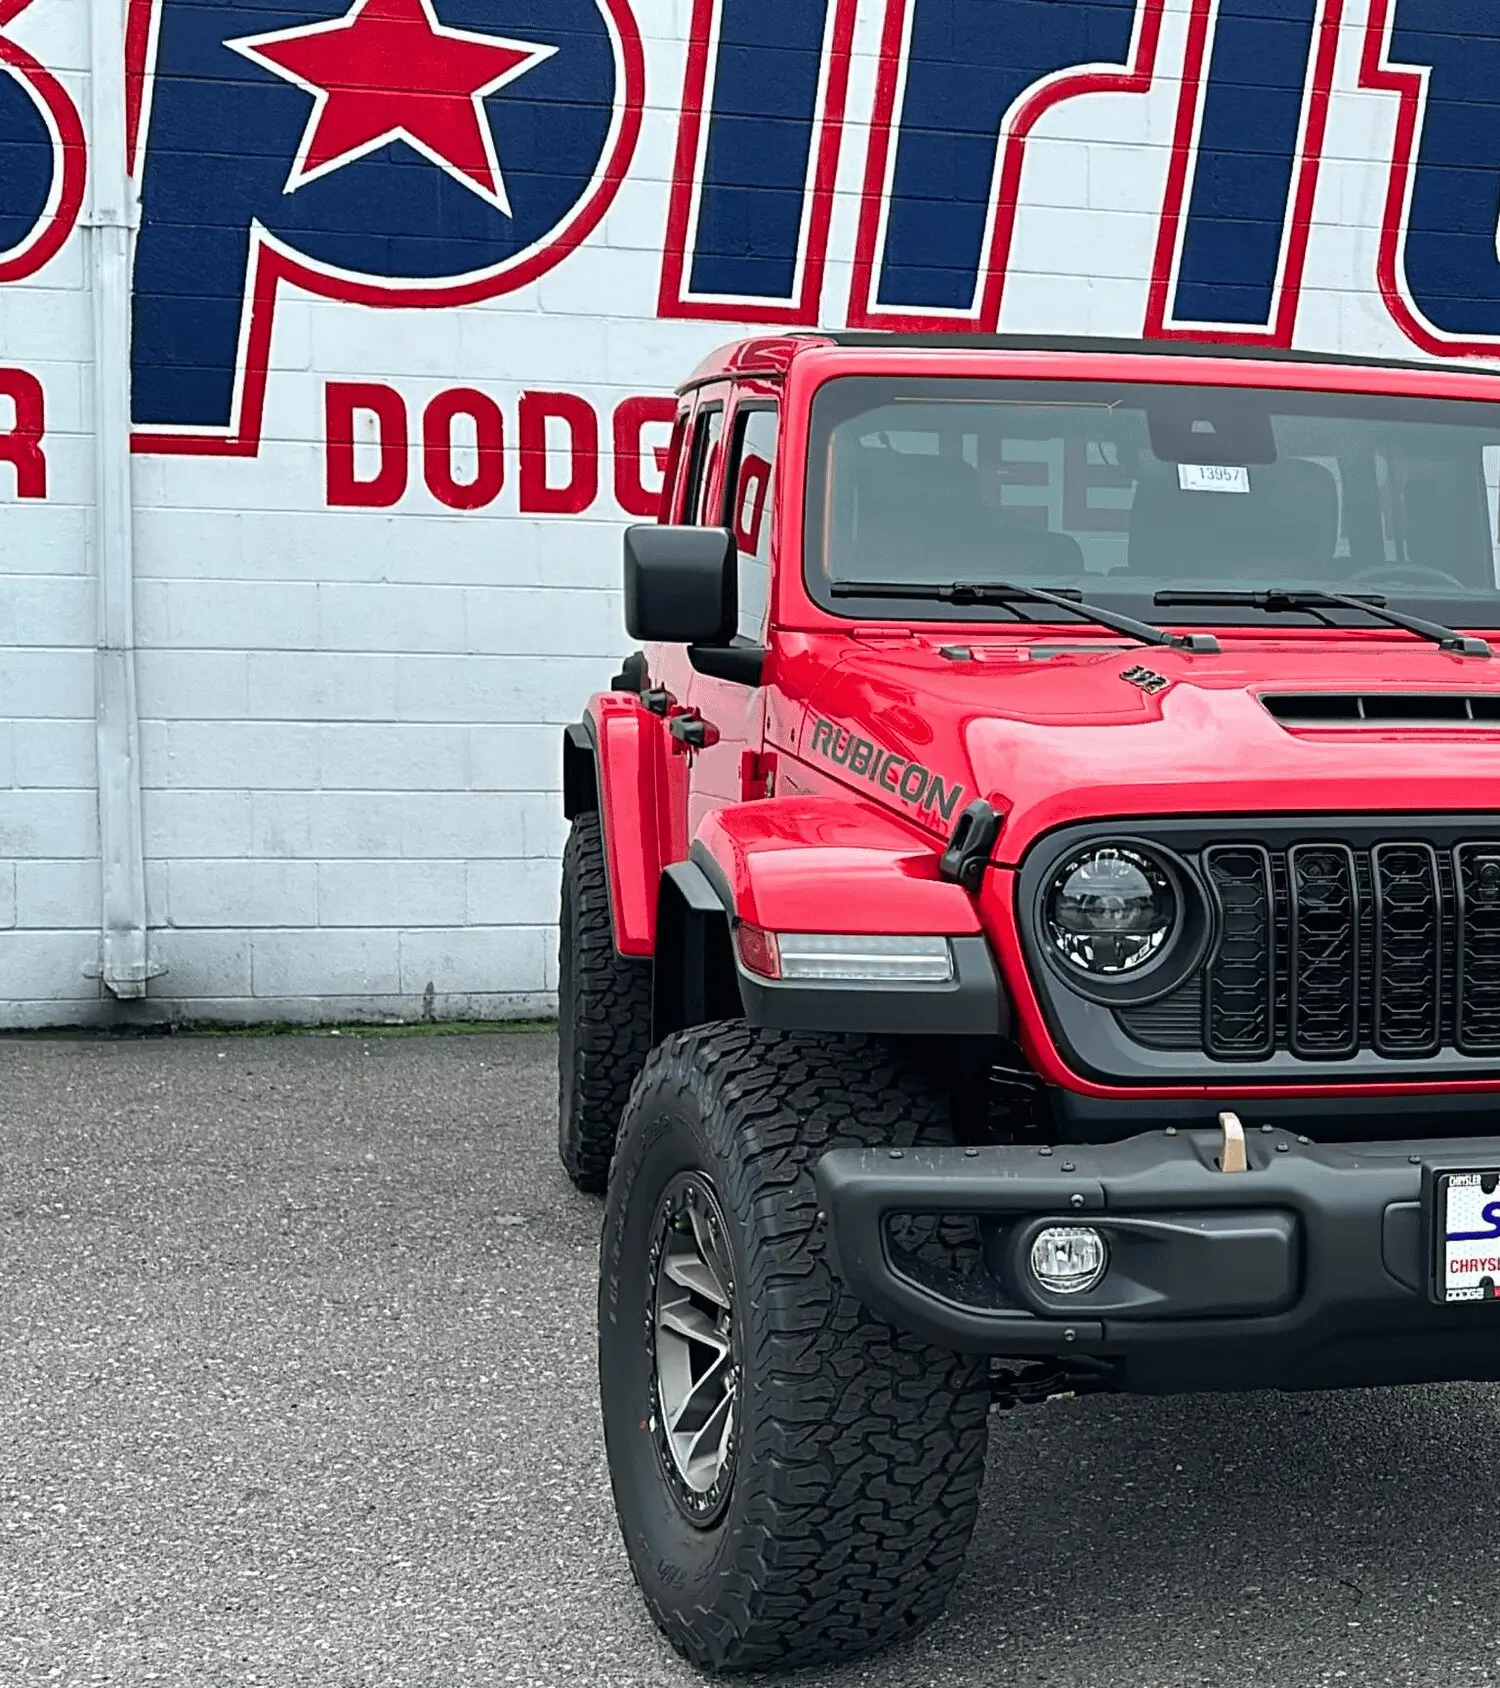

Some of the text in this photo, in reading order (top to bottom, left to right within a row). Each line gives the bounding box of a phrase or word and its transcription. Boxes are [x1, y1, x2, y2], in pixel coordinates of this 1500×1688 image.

[325, 380, 680, 516] DODG
[1200, 467, 1239, 481] 13957
[811, 717, 964, 821] RUBICON
